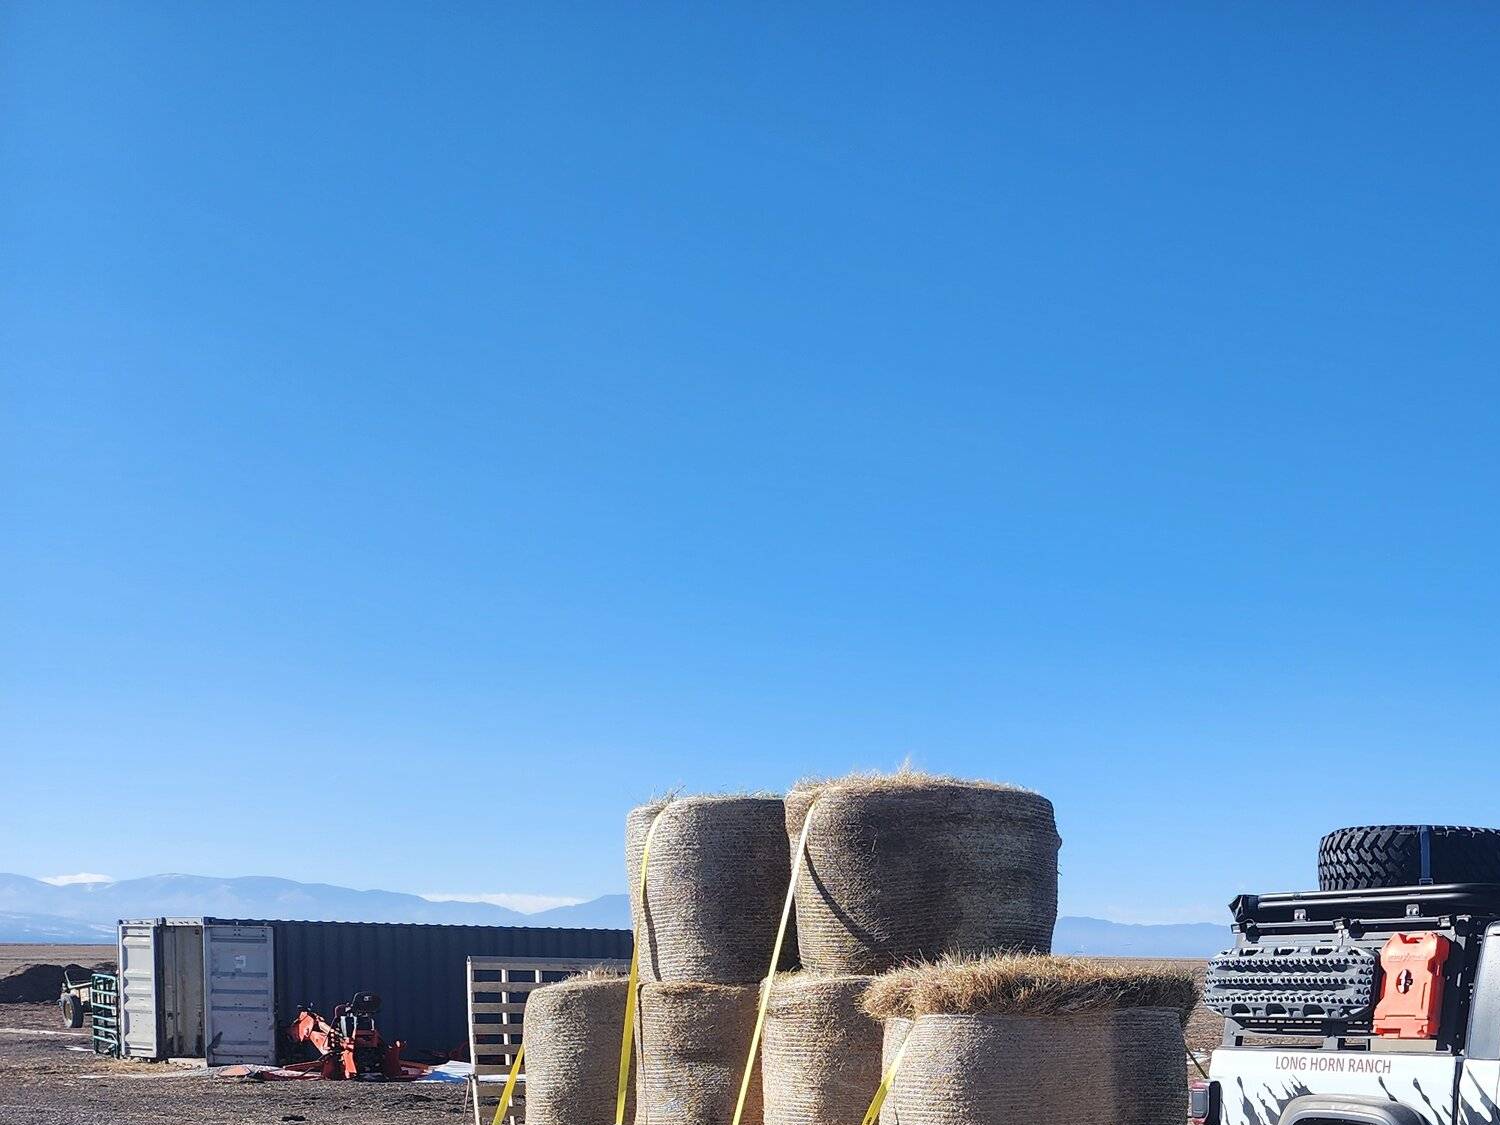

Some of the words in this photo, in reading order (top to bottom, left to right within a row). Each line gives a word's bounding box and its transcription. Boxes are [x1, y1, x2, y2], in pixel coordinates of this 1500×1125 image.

[1275, 1055, 1307, 1070] LONG
[1310, 1057, 1345, 1072] HORN
[1347, 1058, 1391, 1074] RANCH
